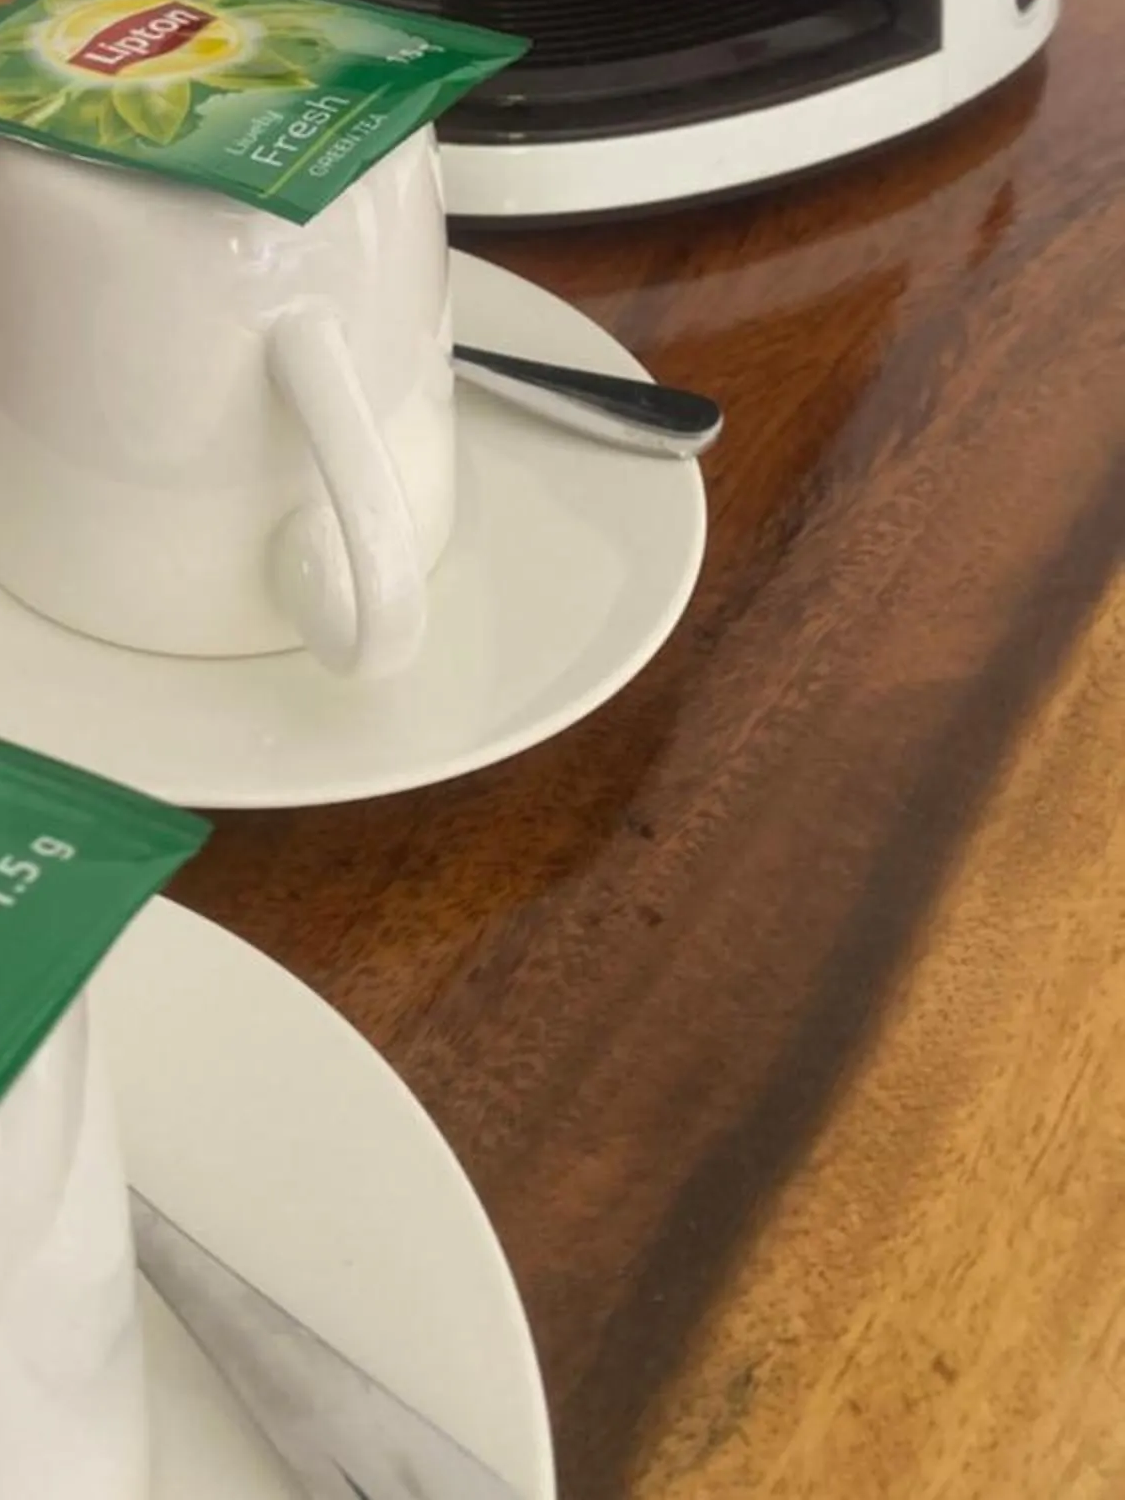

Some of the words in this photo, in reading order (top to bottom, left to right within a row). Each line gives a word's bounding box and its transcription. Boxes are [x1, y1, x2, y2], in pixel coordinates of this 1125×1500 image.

[83, 8, 201, 66] Lipton
[251, 95, 351, 167] Fresh
[308, 132, 361, 177] GREEN
[352, 112, 388, 135] TEA
[30, 834, 75, 861] g
